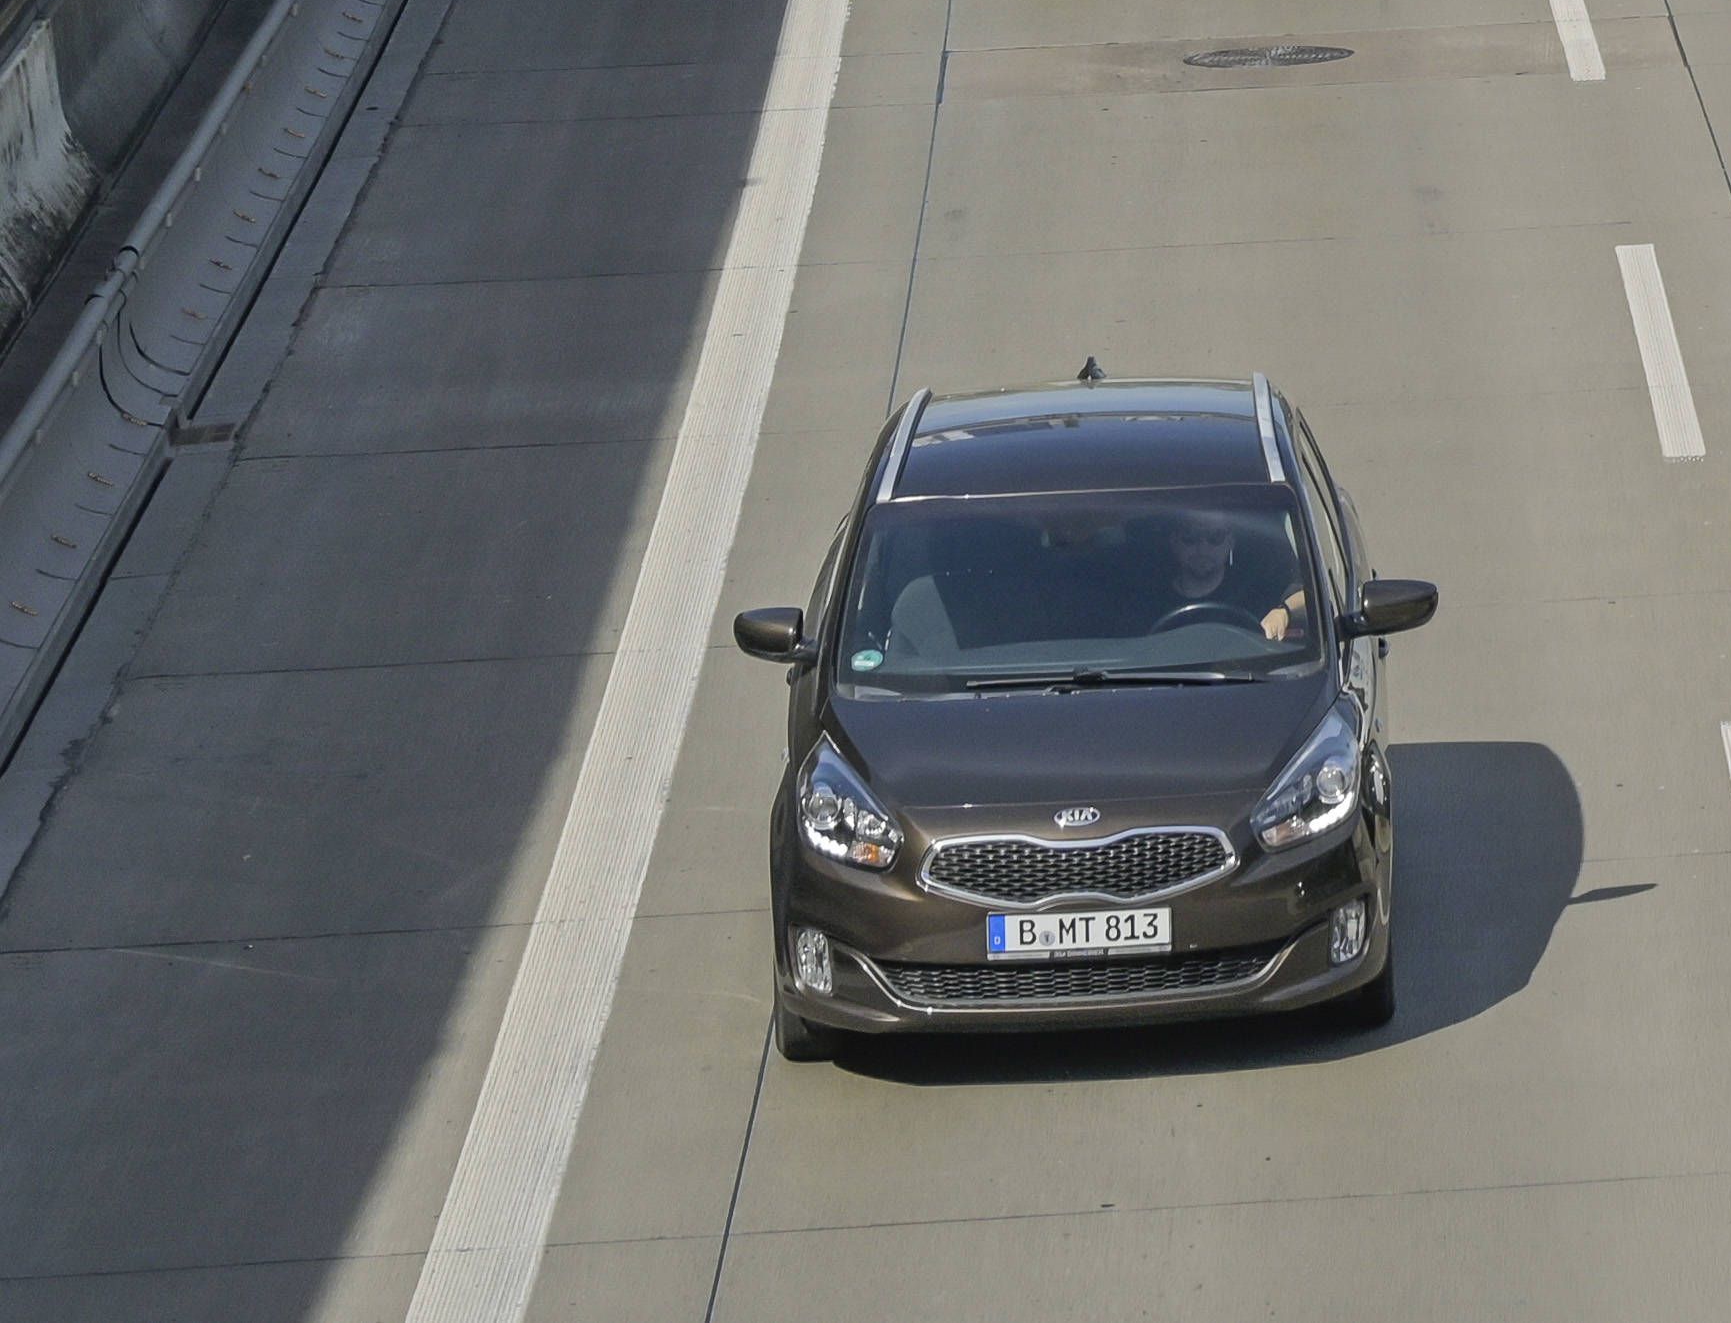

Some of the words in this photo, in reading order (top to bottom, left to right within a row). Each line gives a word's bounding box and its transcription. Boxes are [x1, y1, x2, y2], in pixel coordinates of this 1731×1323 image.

[1019, 918, 1038, 946] B
[1058, 916, 1097, 945] MT
[1105, 913, 1159, 942] 813
